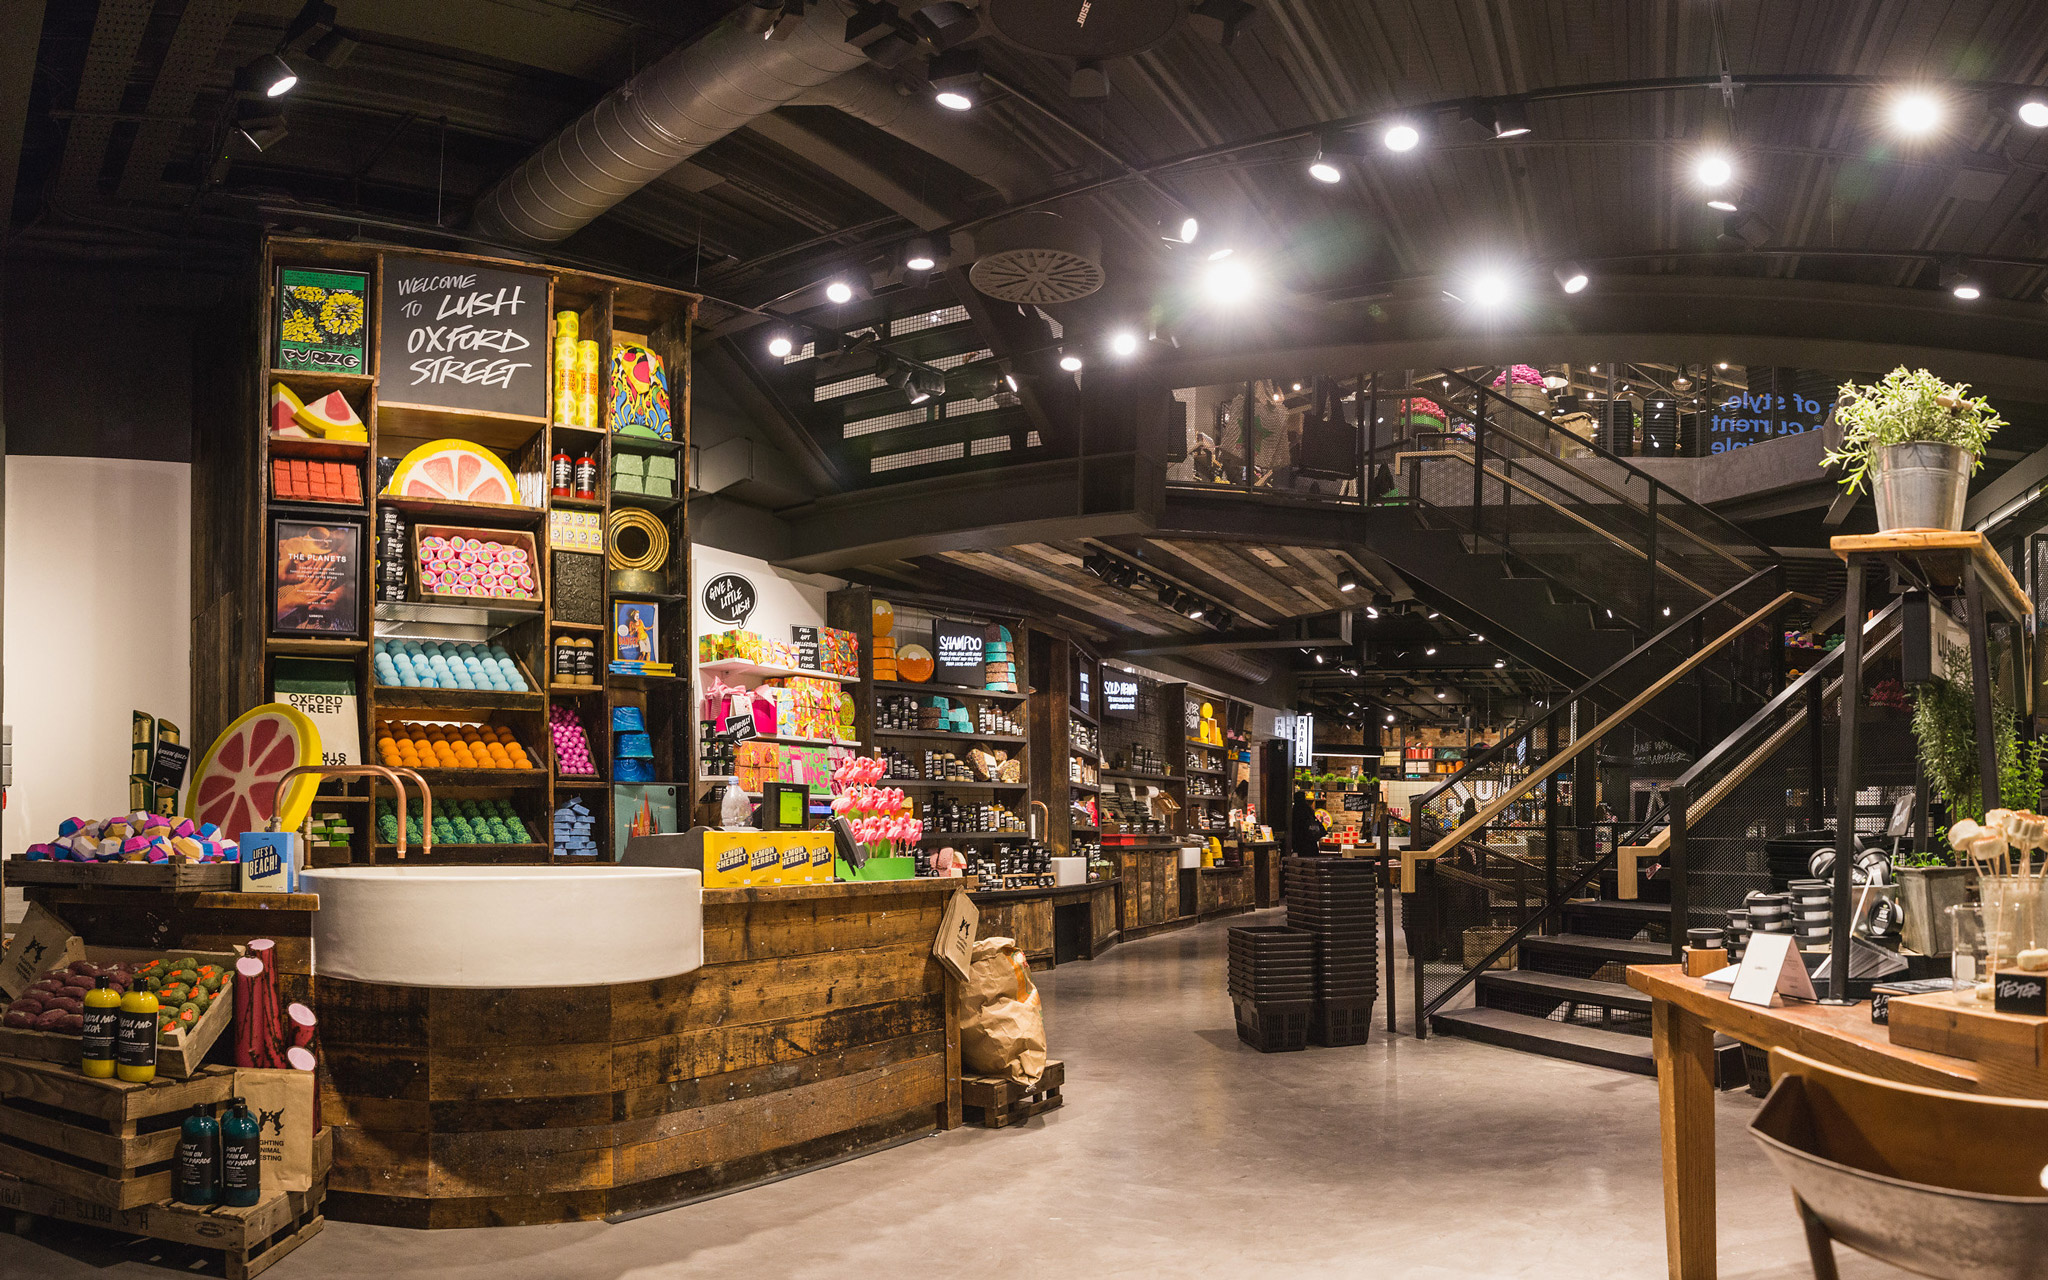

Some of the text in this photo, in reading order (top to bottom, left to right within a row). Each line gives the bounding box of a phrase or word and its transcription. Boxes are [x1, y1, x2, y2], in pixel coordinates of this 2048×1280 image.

[1077, 0, 1091, 27] BOSE
[398, 274, 477, 295] WELCOME
[401, 286, 525, 320] TO LUSH
[407, 325, 530, 353] OXFORD
[410, 356, 532, 388] STREET
[307, 554, 347, 563] PLANETS
[709, 579, 732, 601] GIVE A
[720, 587, 742, 609] LITTLE
[731, 597, 750, 618] LUSH
[939, 635, 982, 650] SHAMPOO
[1104, 681, 1120, 695] SOLID
[1120, 682, 1138, 695] HENNA
[289, 694, 343, 704] OXFORD
[291, 703, 342, 714] STREET
[813, 752, 826, 764] OF
[779, 761, 828, 788] BAING
[253, 845, 274, 860] LIFE'S A
[720, 847, 743, 861] LEMON
[783, 846, 804, 859] EMON
[812, 846, 826, 858] MON
[250, 854, 278, 877] BEACH!
[716, 853, 747, 870] SHERBET
[751, 853, 778, 868] HERBET
[782, 853, 807, 867] HERBET
[812, 853, 829, 868] RBET
[134, 1020, 152, 1029] AND
[189, 1157, 212, 1165] PARADE
